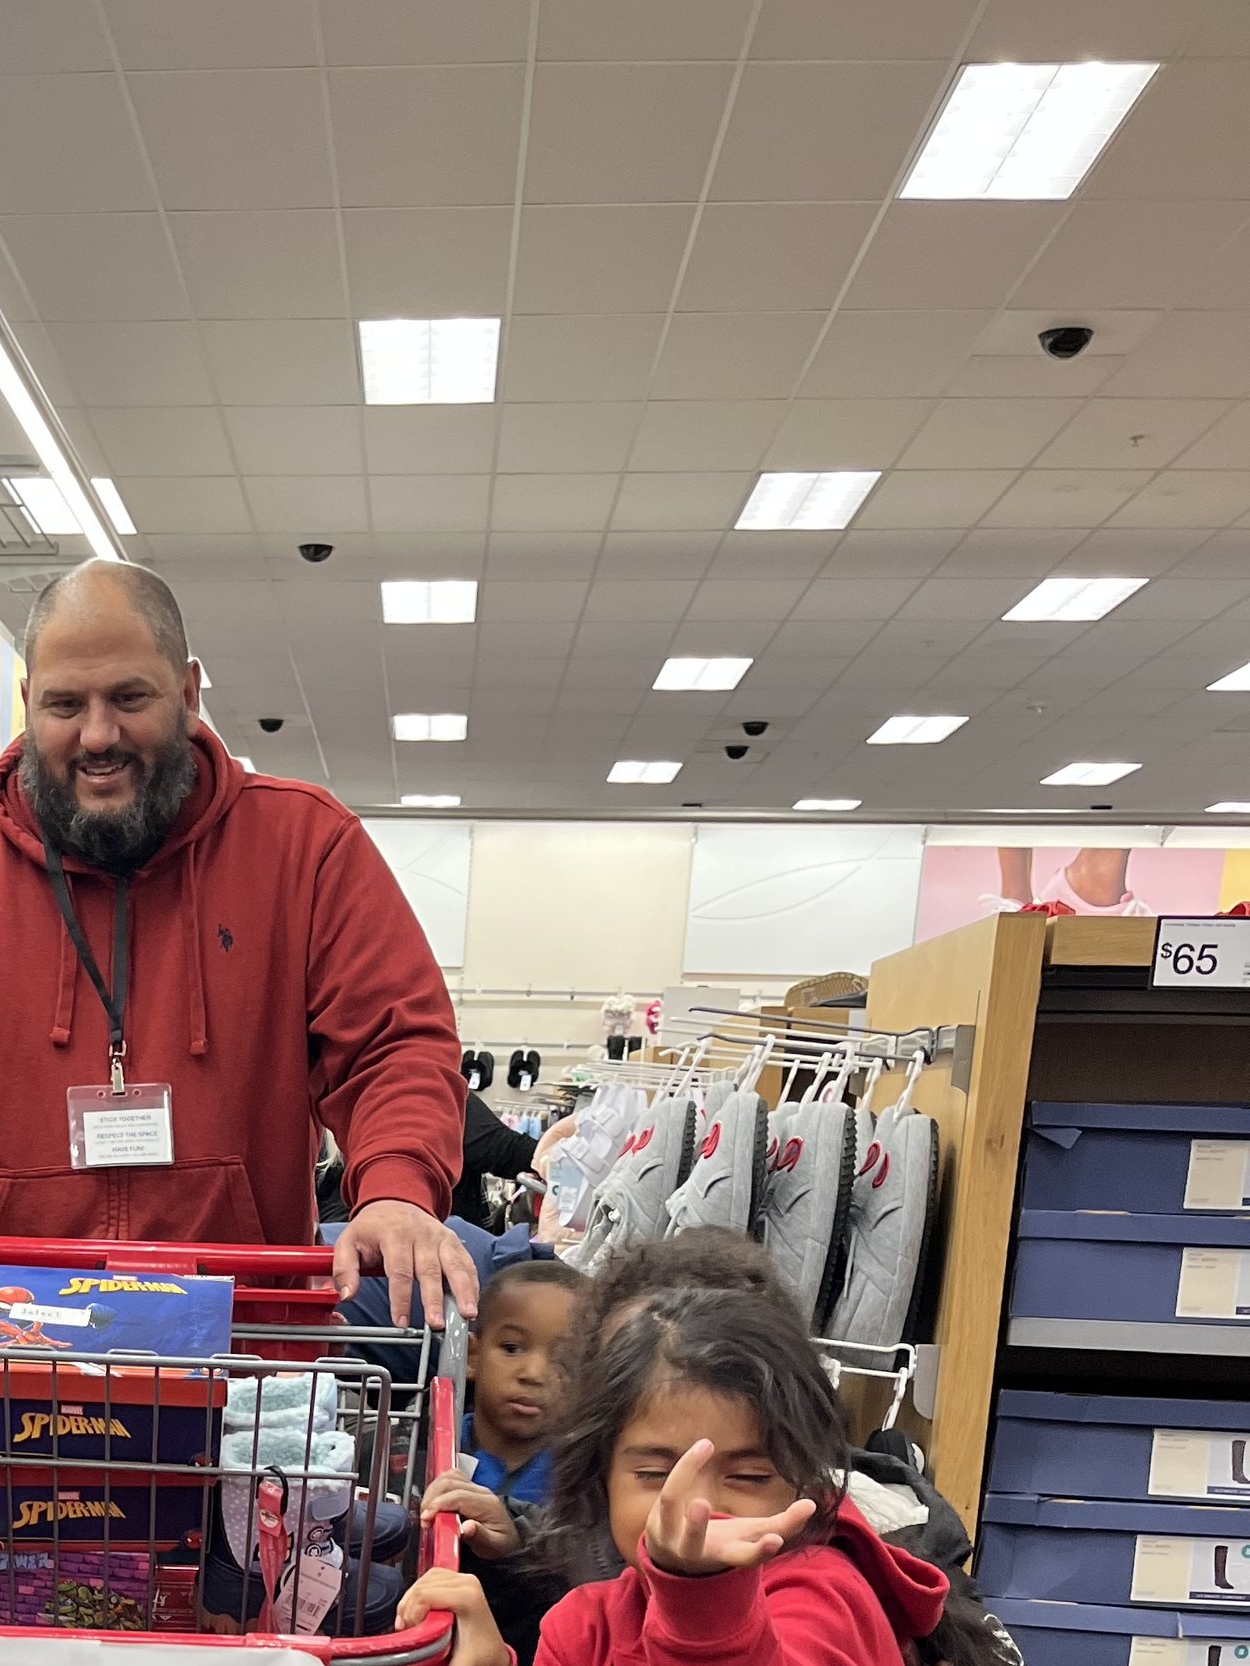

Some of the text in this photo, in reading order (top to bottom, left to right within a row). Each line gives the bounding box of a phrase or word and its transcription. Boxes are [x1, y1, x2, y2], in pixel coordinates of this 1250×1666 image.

[1160, 941, 1219, 976] $65
[119, 1114, 151, 1122] TOGETHER
[112, 1145, 129, 1153] HAVE
[58, 1276, 188, 1296] SPIDER-MAN
